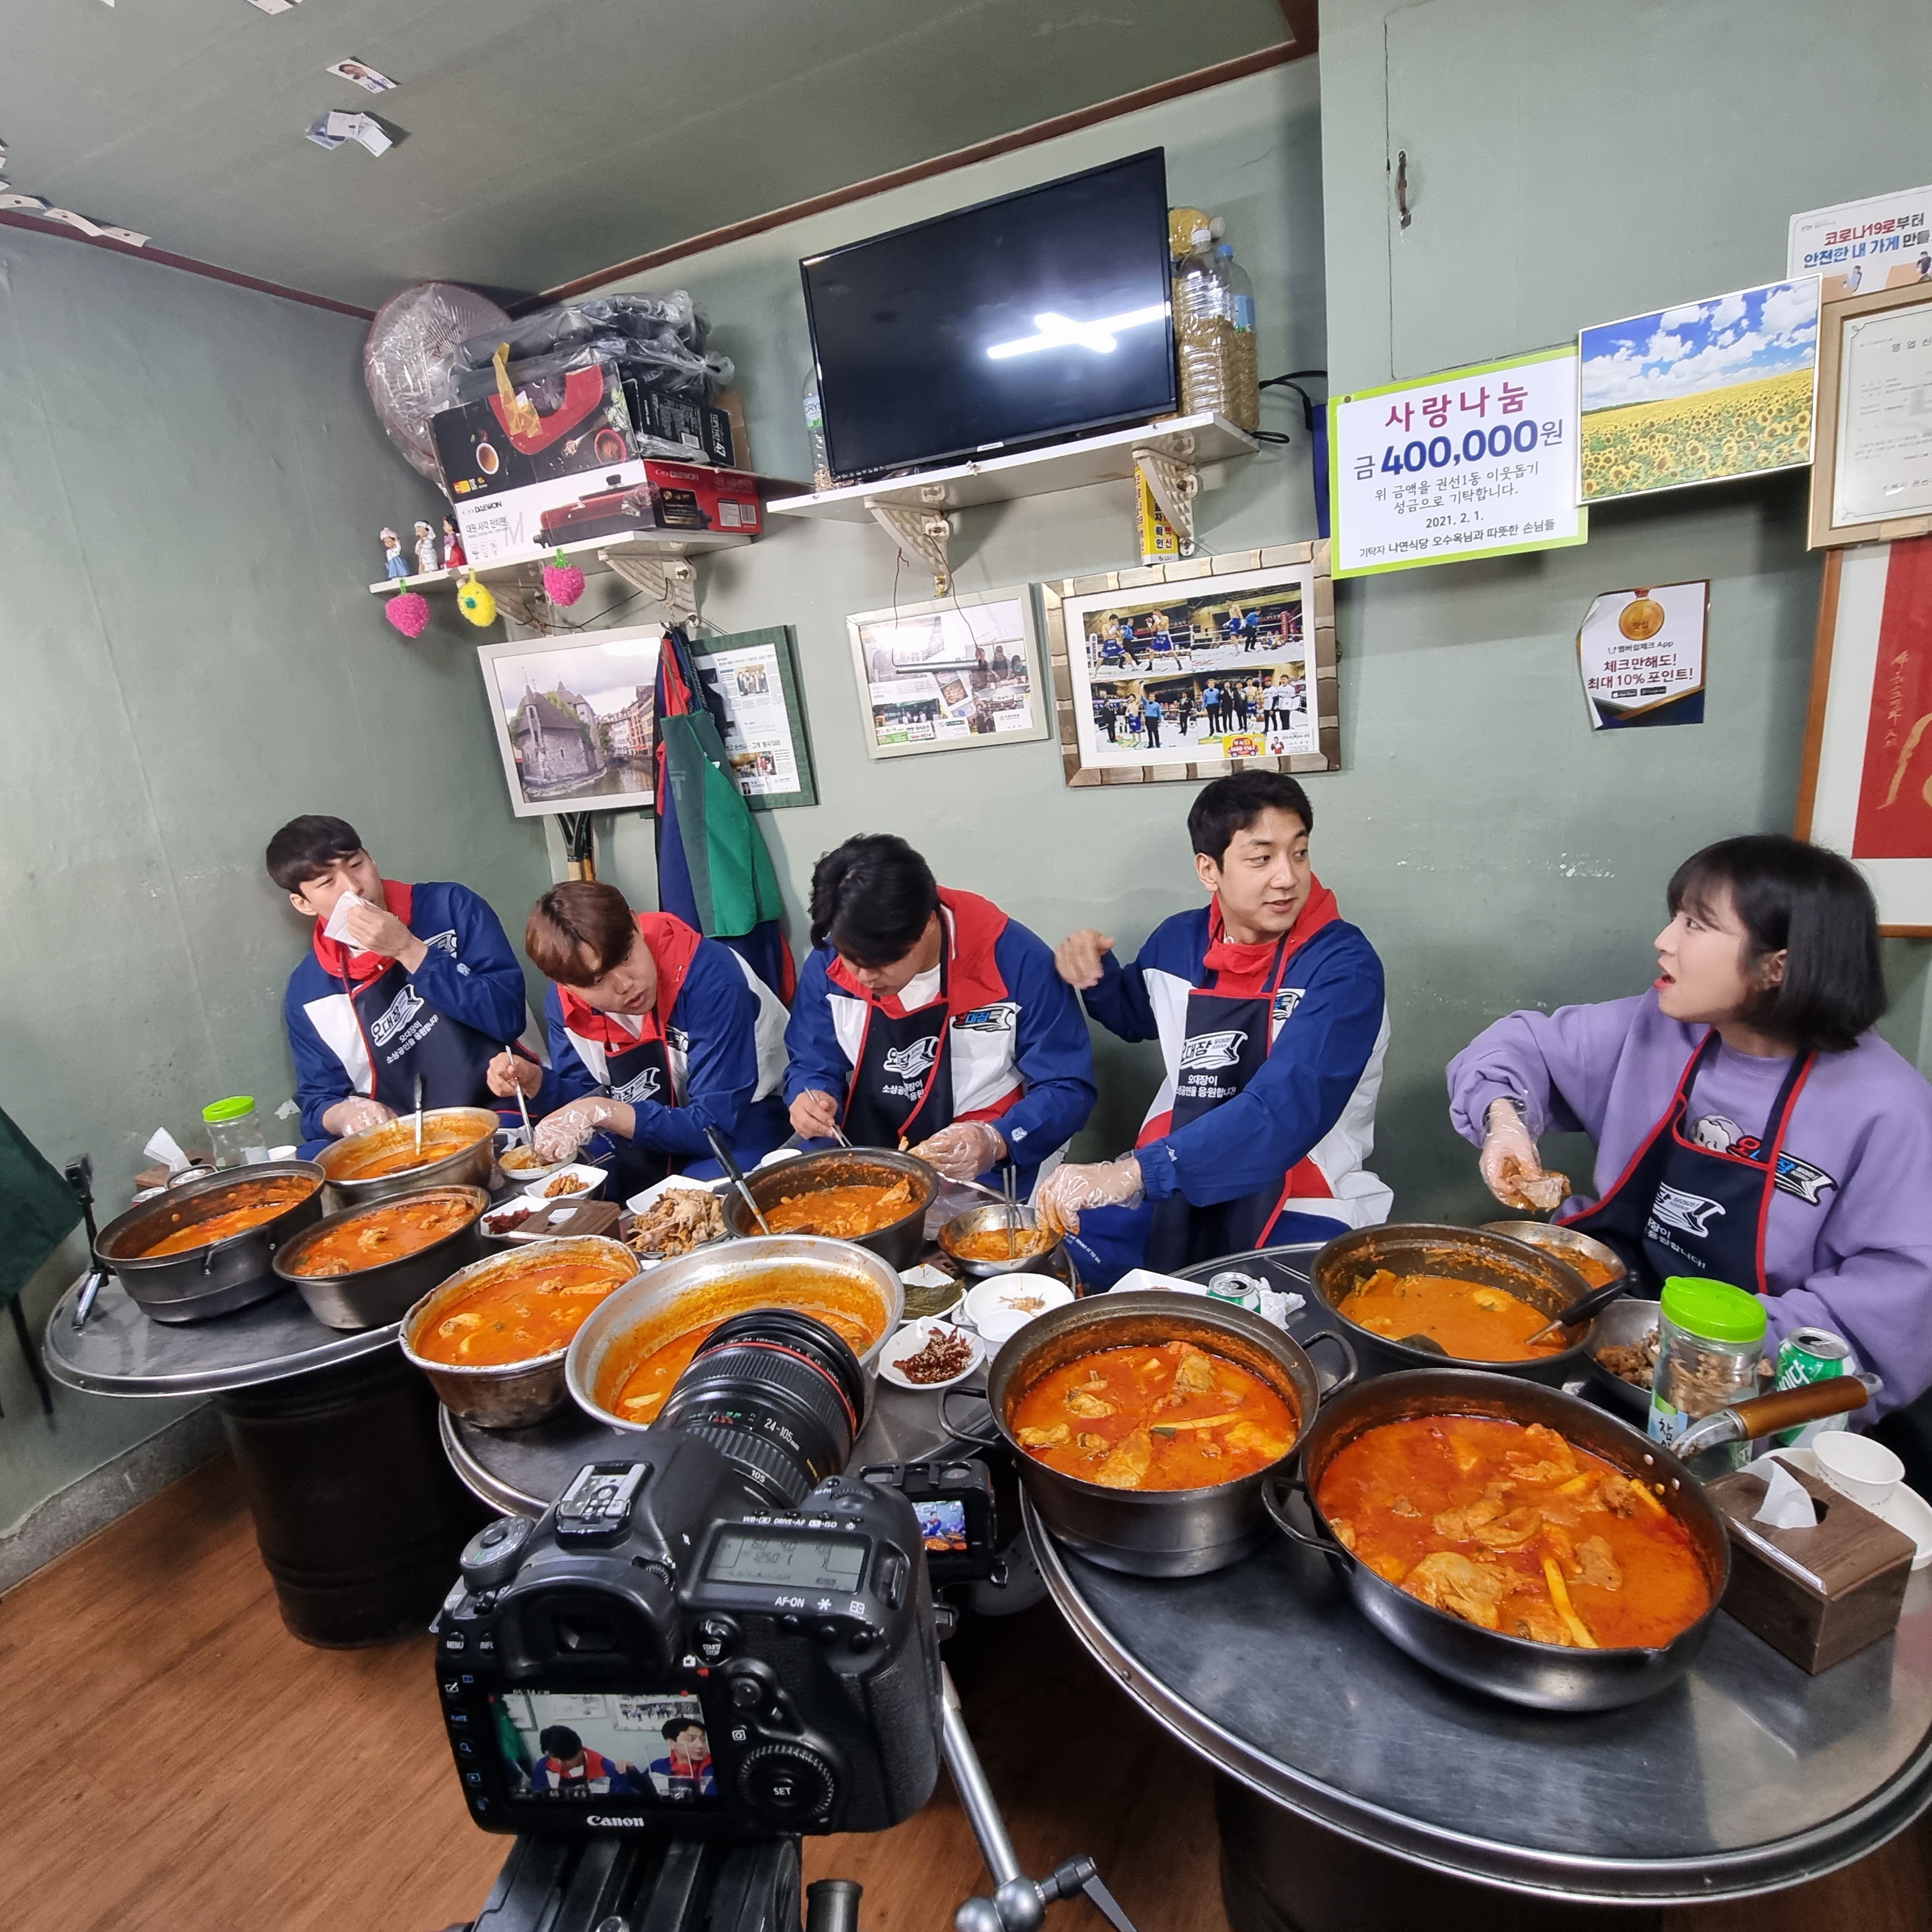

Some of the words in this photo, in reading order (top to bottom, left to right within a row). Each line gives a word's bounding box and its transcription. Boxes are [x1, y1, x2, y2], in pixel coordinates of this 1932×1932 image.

[1824, 213, 1924, 246] 코로나19로부터
[1804, 246, 1848, 268] 안전한
[1852, 242, 1866, 258] 내
[1870, 235, 1900, 254] 가게
[1903, 229, 1932, 248] 만들
[1354, 456, 1376, 480] 금
[1375, 489, 1386, 501] 위
[1392, 481, 1430, 500] 금액을
[1436, 475, 1482, 493] 권선1동
[1487, 461, 1538, 483] 이웃돕기
[474, 501, 502, 513] DAEWON
[1394, 498, 1445, 514] 성금으로
[1450, 484, 1518, 505] 기탁합니다.
[1425, 516, 1457, 528] 2021.
[1460, 514, 1470, 524] 2.
[1474, 511, 1483, 521] 1.
[1360, 546, 1385, 557] 기탁자
[1389, 538, 1428, 553] 나연식당
[1432, 530, 1483, 547] 오수옥님과
[1487, 525, 1518, 539] 따뜻한
[1523, 519, 1555, 533] 손님들
[1604, 654, 1676, 672] 체크만해도!
[1588, 675, 1613, 689] 최대
[1617, 673, 1645, 686] 10%
[1647, 668, 1693, 684] 포인트!
[399, 1020, 422, 1043] 오대장이
[387, 1038, 416, 1064] 소상공인을
[1188, 1075, 1218, 1086] 오대장이
[1176, 1085, 1197, 1096] 상공인을
[764, 1418, 800, 1452] 24-105mm
[751, 1469, 767, 1483] 105
[774, 1597, 805, 1608] AF-ON
[447, 1641, 464, 1650] MENU
[774, 1787, 792, 1795] SET
[586, 1815, 645, 1827] Canon
